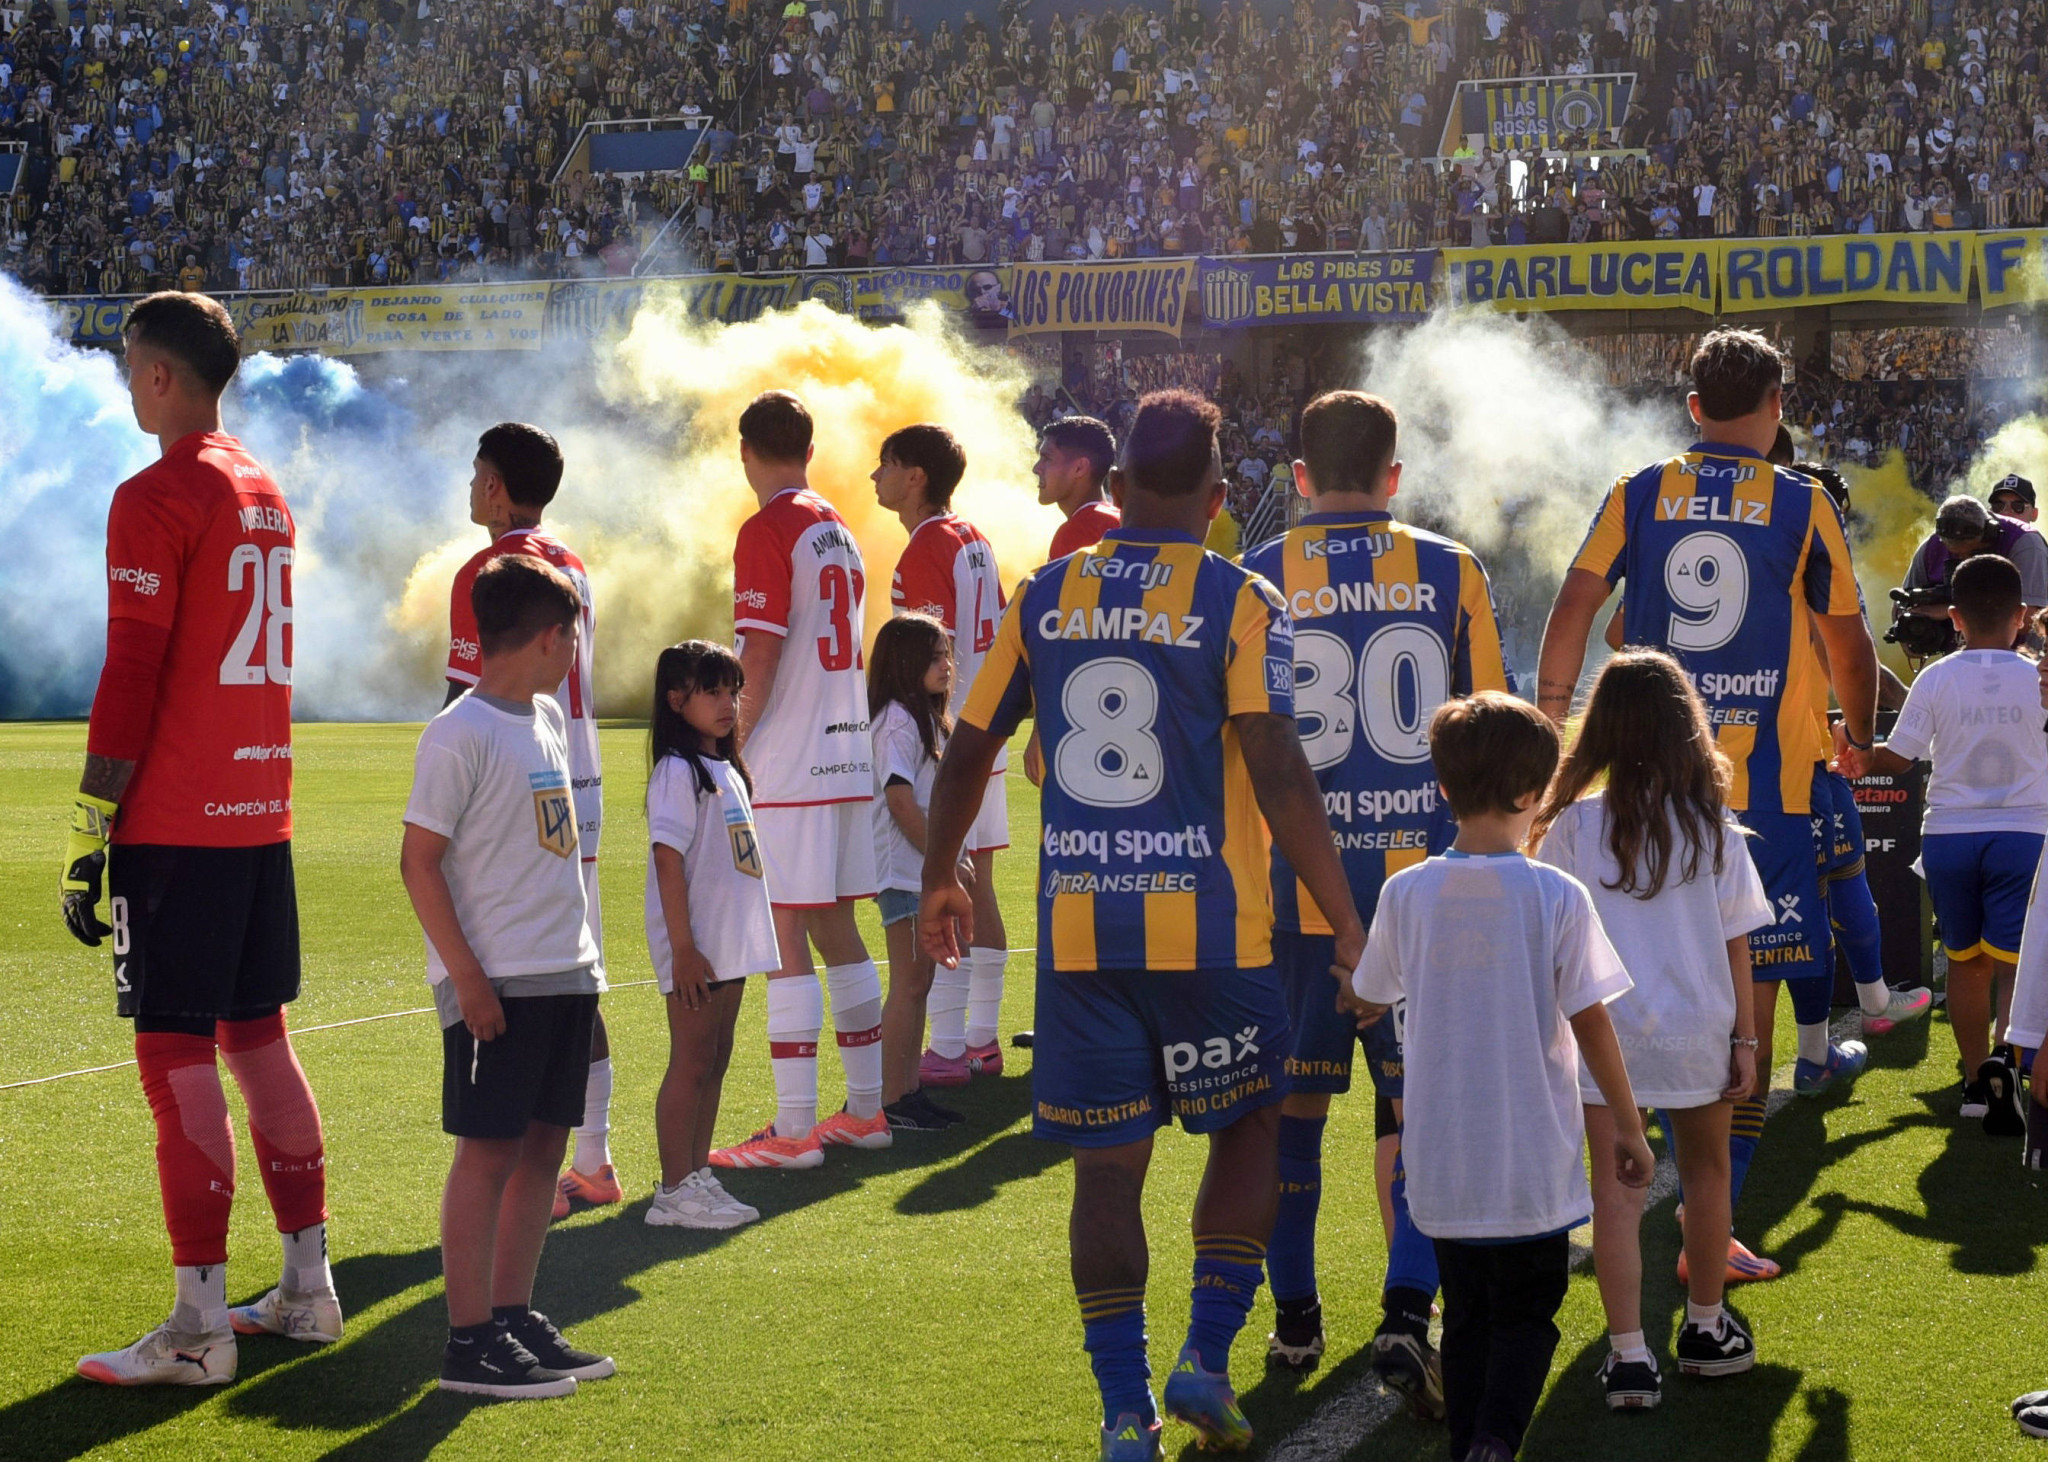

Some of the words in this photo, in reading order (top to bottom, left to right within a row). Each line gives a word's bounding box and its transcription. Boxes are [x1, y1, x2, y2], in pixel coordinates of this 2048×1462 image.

[1503, 100, 1536, 117] LAS
[1493, 121, 1548, 136] ROSAS
[1277, 261, 1315, 281] LOS
[1323, 260, 1381, 279] PIBES
[1390, 259, 1415, 276] DE
[1727, 239, 1962, 299] ROLDAN
[857, 270, 964, 294] RICOTERO
[371, 296, 442, 308] DEJANDO
[458, 291, 545, 304] CUALQUIER
[1013, 269, 1051, 327] LOS
[1056, 267, 1185, 327] POLVORINES
[1255, 283, 1342, 317] BELLA
[1349, 281, 1427, 313] VISTA
[386, 311, 427, 322] COSA
[444, 310, 464, 321] DE
[480, 308, 523, 320] LADO
[272, 322, 289, 343] LA
[290, 319, 328, 343] VIDA
[366, 331, 404, 344] PARA
[420, 329, 472, 342] VERTE
[484, 330, 495, 341] A
[510, 329, 539, 340] VOS
[238, 506, 289, 537] MUSLERA
[1661, 496, 1768, 526] VELIZ
[134, 584, 159, 596] M2V
[1290, 581, 1437, 618] CONNOR
[1664, 530, 1750, 652] 9
[219, 543, 294, 685] 28
[1038, 607, 1204, 649] CAMPAZ
[457, 651, 477, 662] M2V
[1293, 621, 1450, 771] 30
[1701, 669, 1780, 701] sportif
[1054, 656, 1164, 808] 8
[1357, 780, 1437, 822] sporti
[1854, 787, 1908, 803] etano
[204, 799, 266, 816] CAMPEÓN
[270, 799, 283, 812] DEL
[1857, 804, 1891, 813] lausura
[1114, 824, 1213, 863] sportif
[1333, 831, 1427, 849] ANSELEC
[1866, 839, 1896, 852] PF
[1060, 871, 1196, 893] TRANSELEC
[1167, 1062, 1259, 1093] assistance
[1211, 1074, 1272, 1109] CENTRAL
[1038, 1100, 1083, 1127] ROSARIO
[1085, 1094, 1153, 1126] CENTRAL
[271, 1161, 282, 1172] E
[209, 1179, 222, 1193] E
